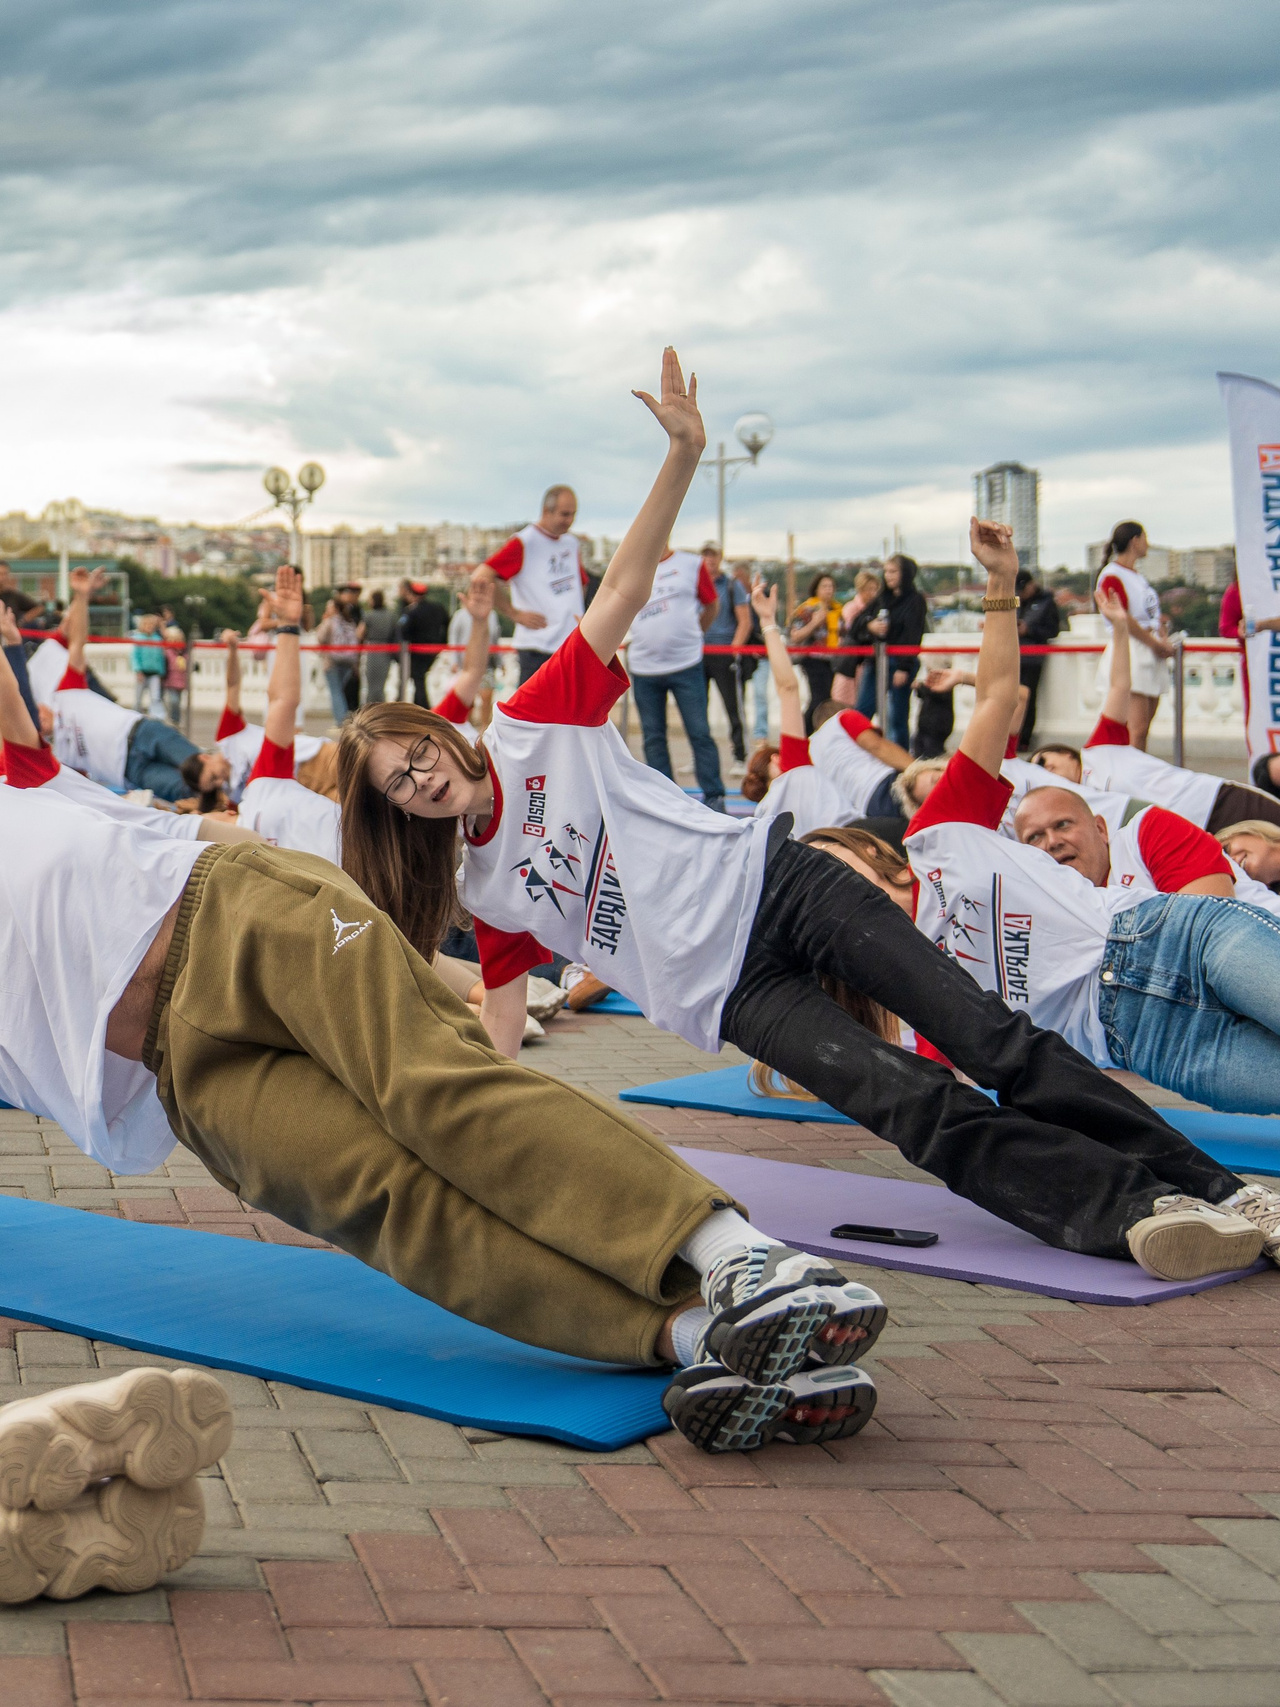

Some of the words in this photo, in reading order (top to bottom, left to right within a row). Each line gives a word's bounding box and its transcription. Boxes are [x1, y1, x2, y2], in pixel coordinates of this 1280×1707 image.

[523, 791, 546, 838] BOSCO
[332, 919, 373, 955] JORDAN
[591, 853, 627, 956] ЗАРЯДК
[1004, 912, 1032, 1004] ЗАРЯДКА
